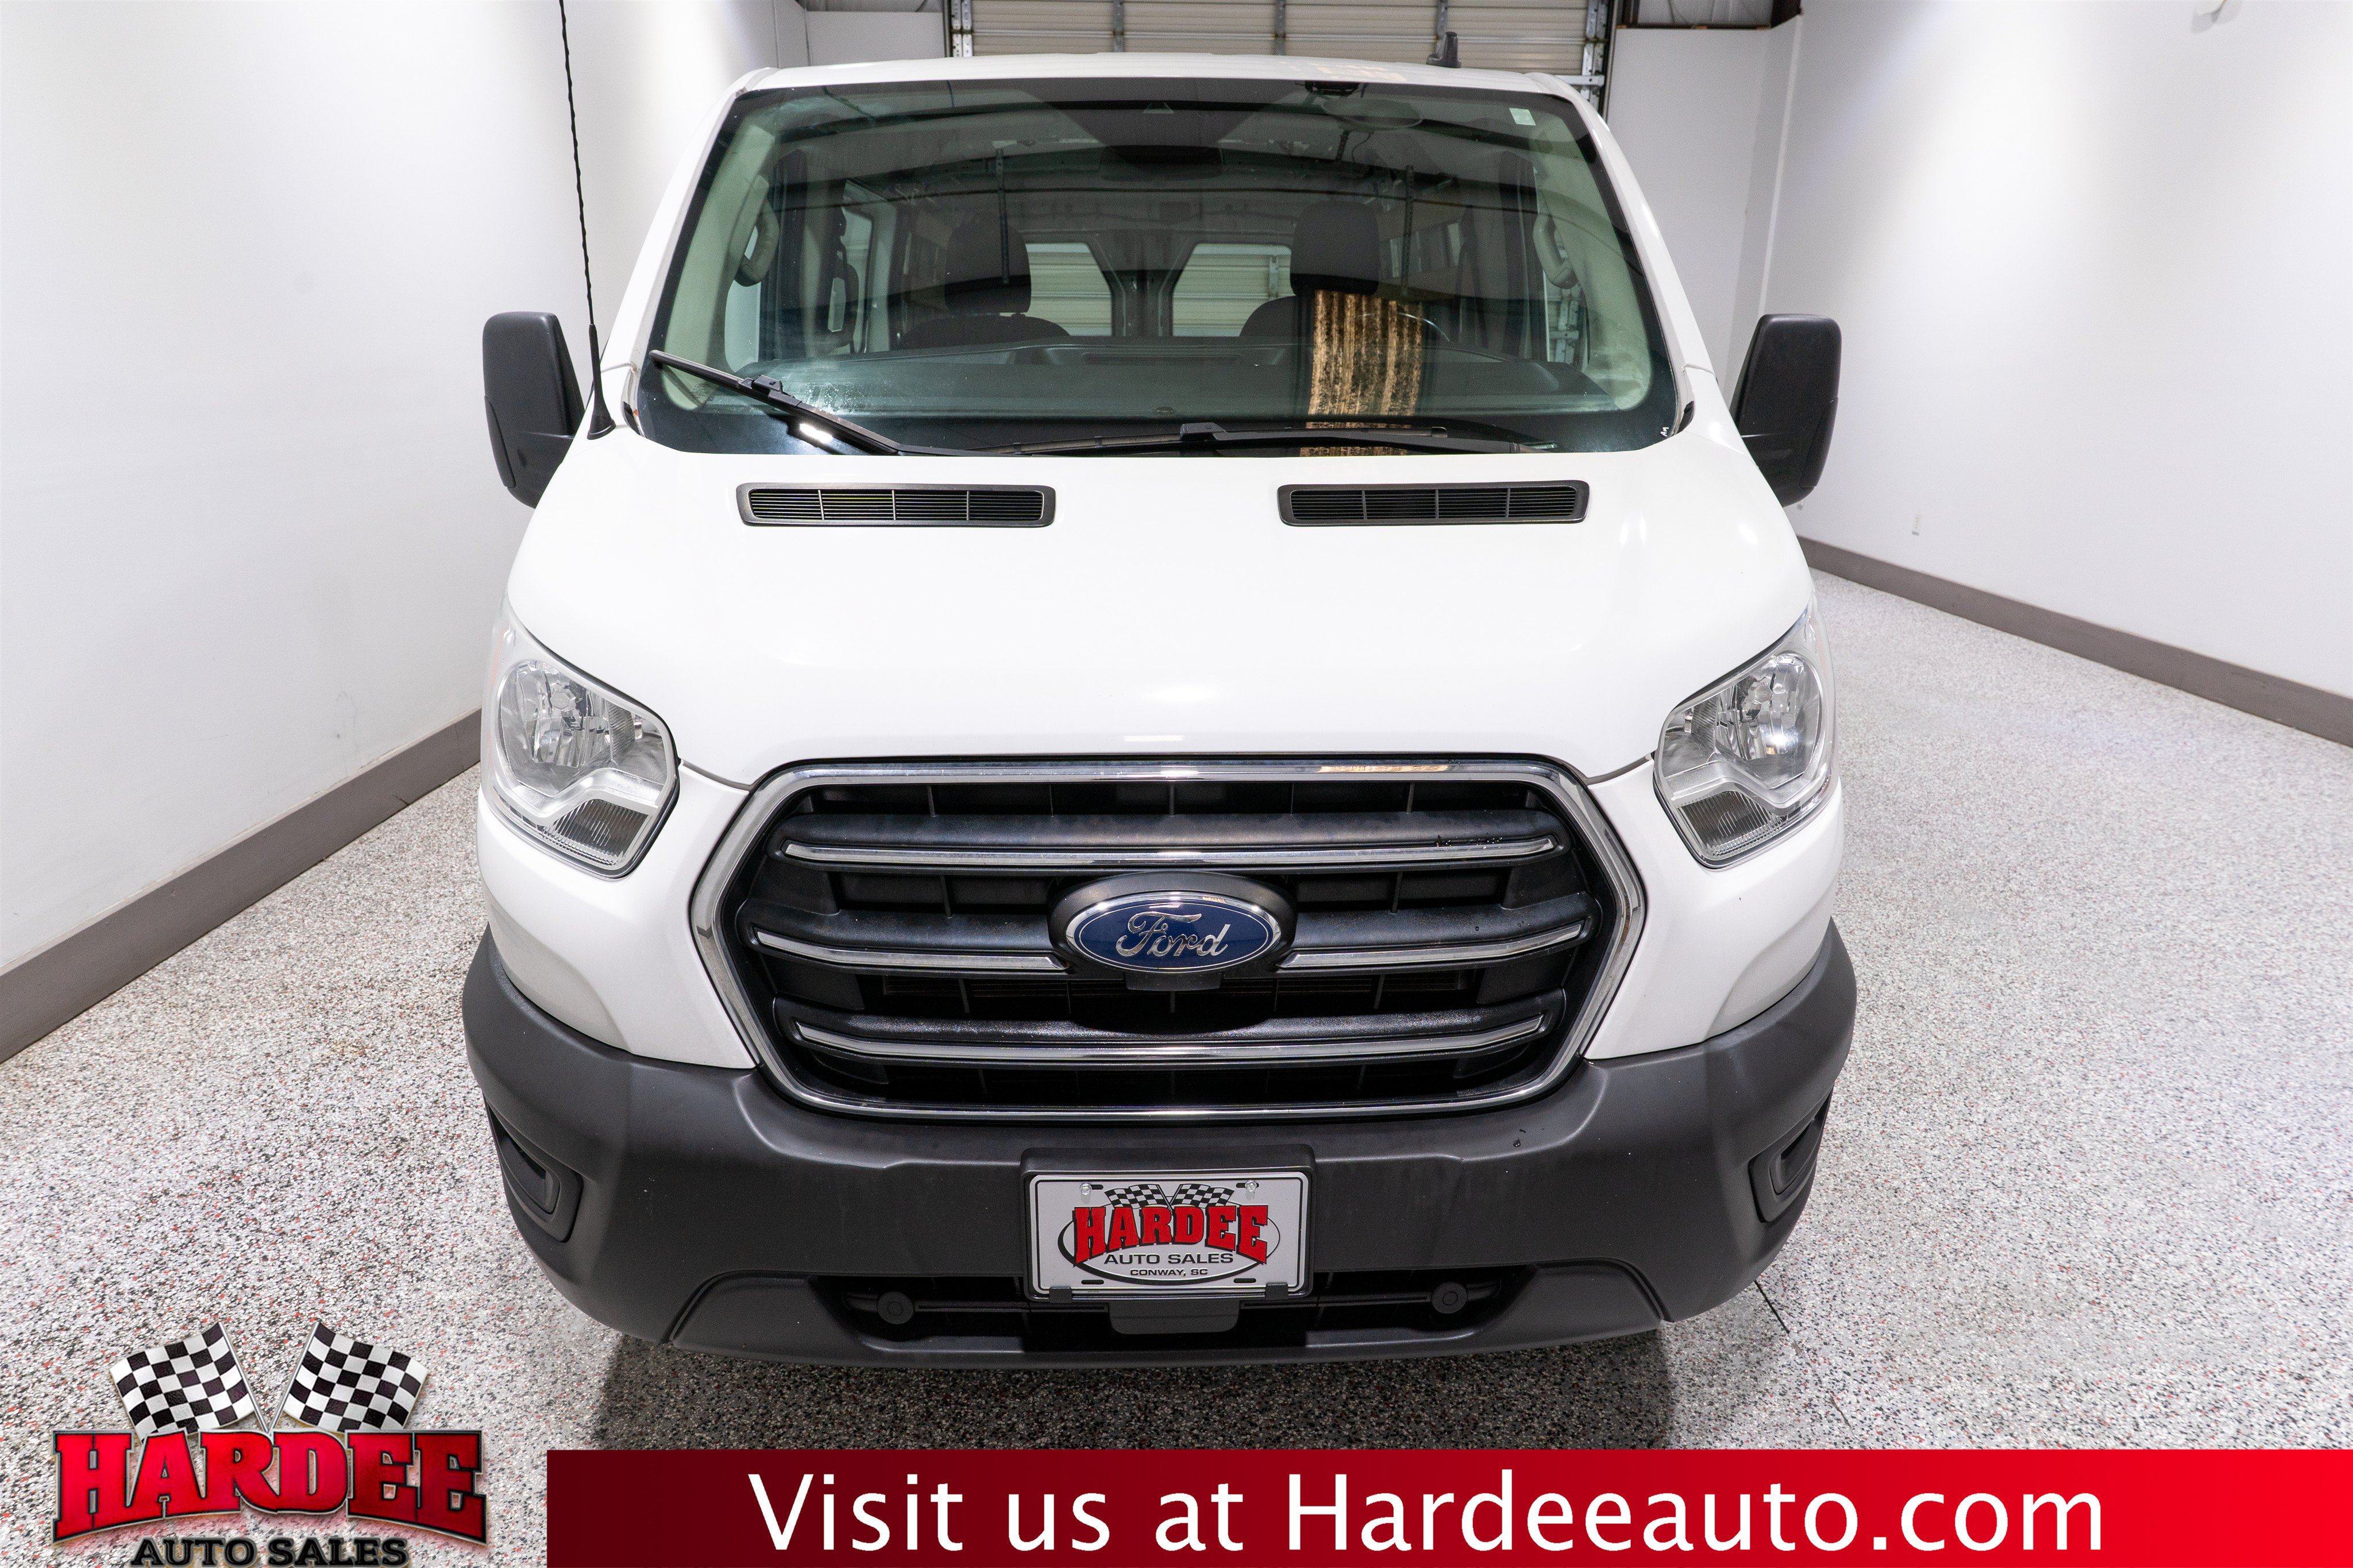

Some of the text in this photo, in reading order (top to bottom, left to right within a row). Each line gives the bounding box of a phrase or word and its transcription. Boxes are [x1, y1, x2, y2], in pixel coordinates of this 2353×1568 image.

[1116, 911, 1230, 957] Ford
[1073, 1205, 1268, 1266] HARDEE
[1104, 1253, 1234, 1264] AUTO SALES
[1130, 1268, 1186, 1277] CONWAY,
